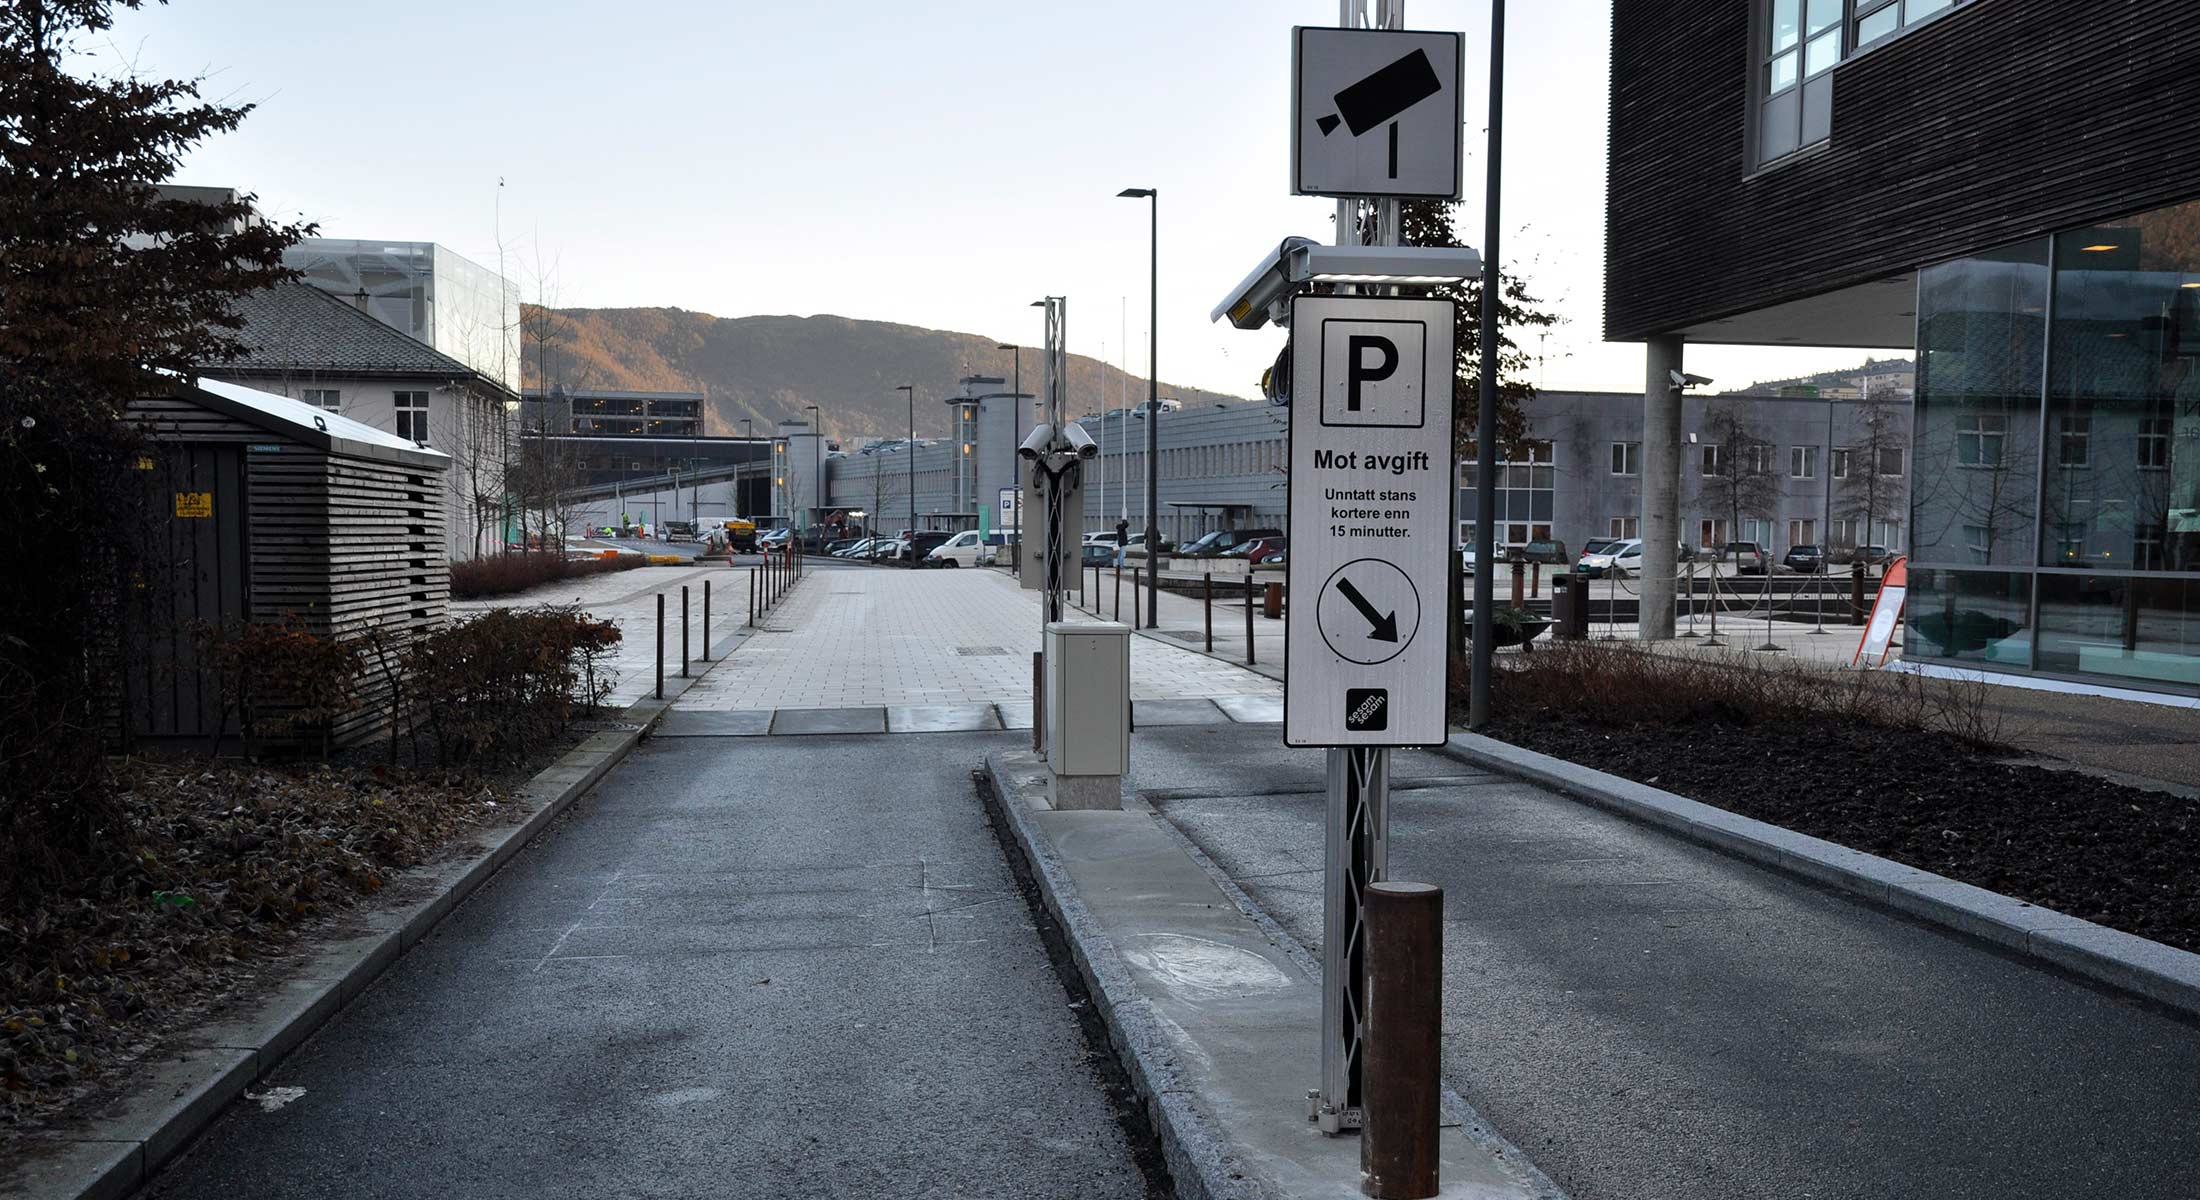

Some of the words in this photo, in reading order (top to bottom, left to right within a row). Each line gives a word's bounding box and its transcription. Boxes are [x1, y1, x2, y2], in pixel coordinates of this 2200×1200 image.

[1348, 335, 1399, 411] P
[1314, 449, 1357, 469] Mot
[1364, 451, 1429, 475] avgift
[1325, 488, 1375, 501] Unntatt
[1379, 489, 1417, 501] stans
[1331, 507, 1380, 519] kortere
[1384, 510, 1410, 519] enn
[1330, 525, 1346, 537] 15
[1349, 525, 1411, 538] minutter.
[1348, 695, 1377, 724] sesam
[1357, 696, 1386, 725] sesam
